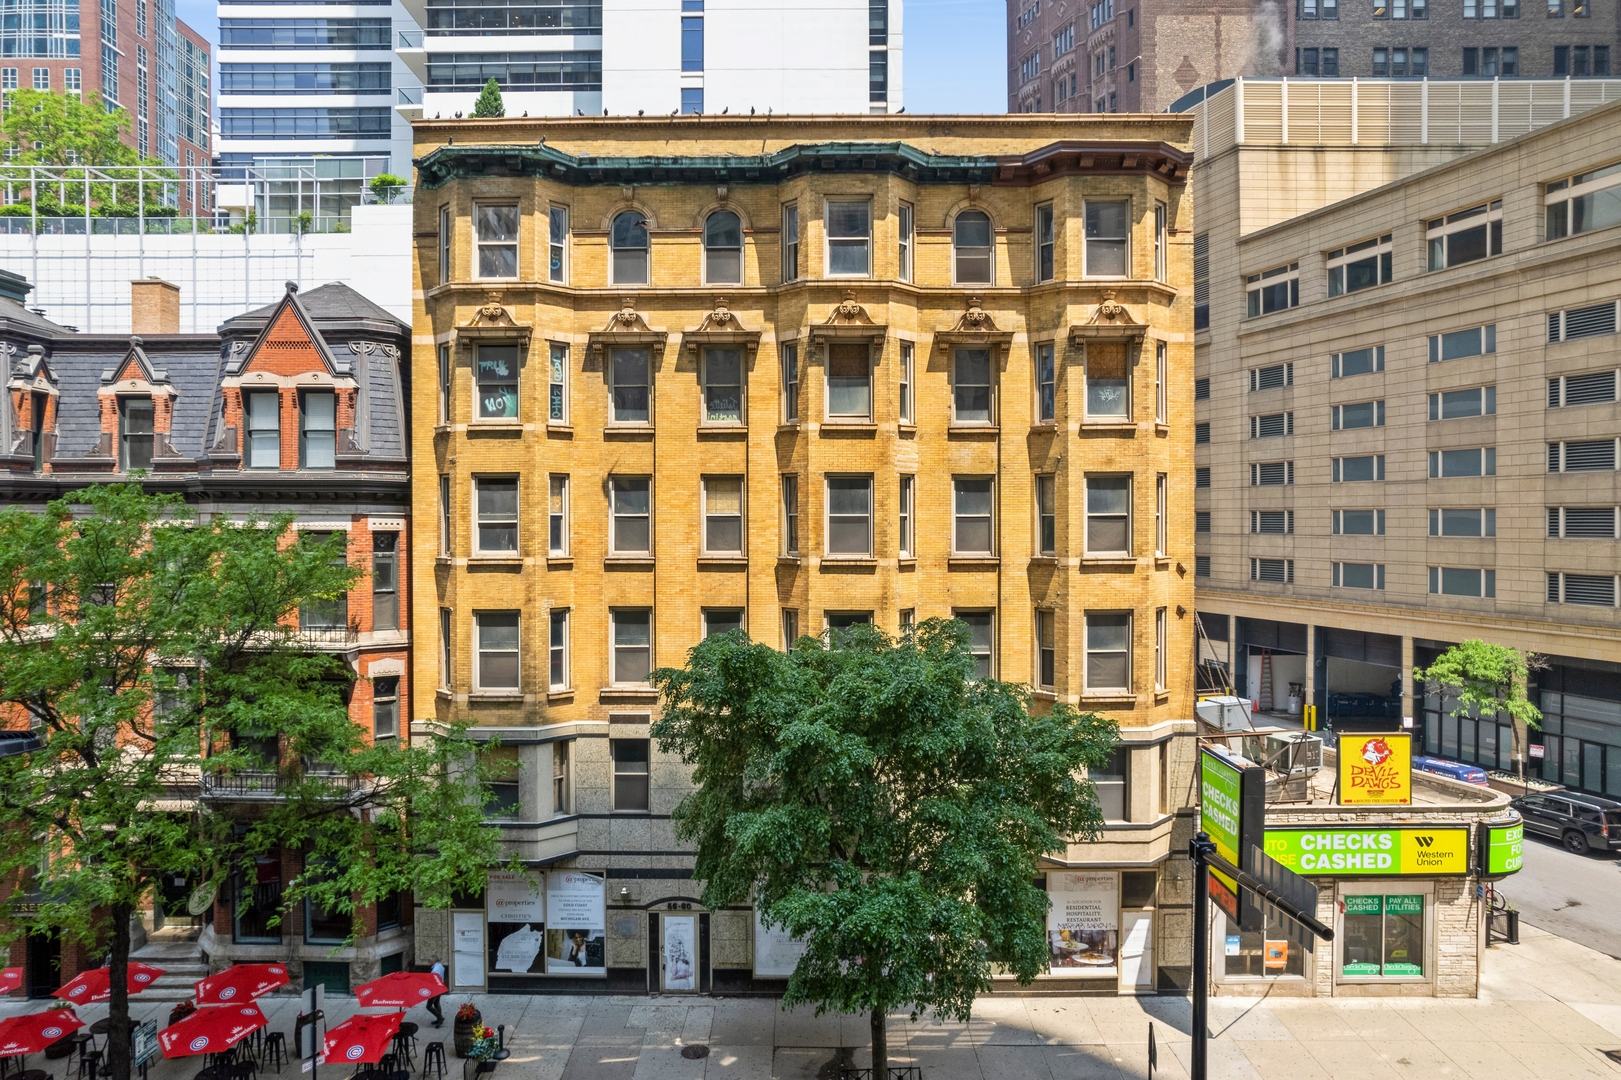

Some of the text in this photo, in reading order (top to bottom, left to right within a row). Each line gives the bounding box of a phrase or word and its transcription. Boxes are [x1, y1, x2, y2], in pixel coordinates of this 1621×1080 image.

[1351, 765, 1399, 781] DEVIL
[1351, 776, 1401, 789] DAWGS
[1203, 781, 1238, 817] CHECKS
[1203, 800, 1237, 836] CASHED
[1300, 834, 1392, 850] CHECKS
[1300, 854, 1392, 870] CASHED
